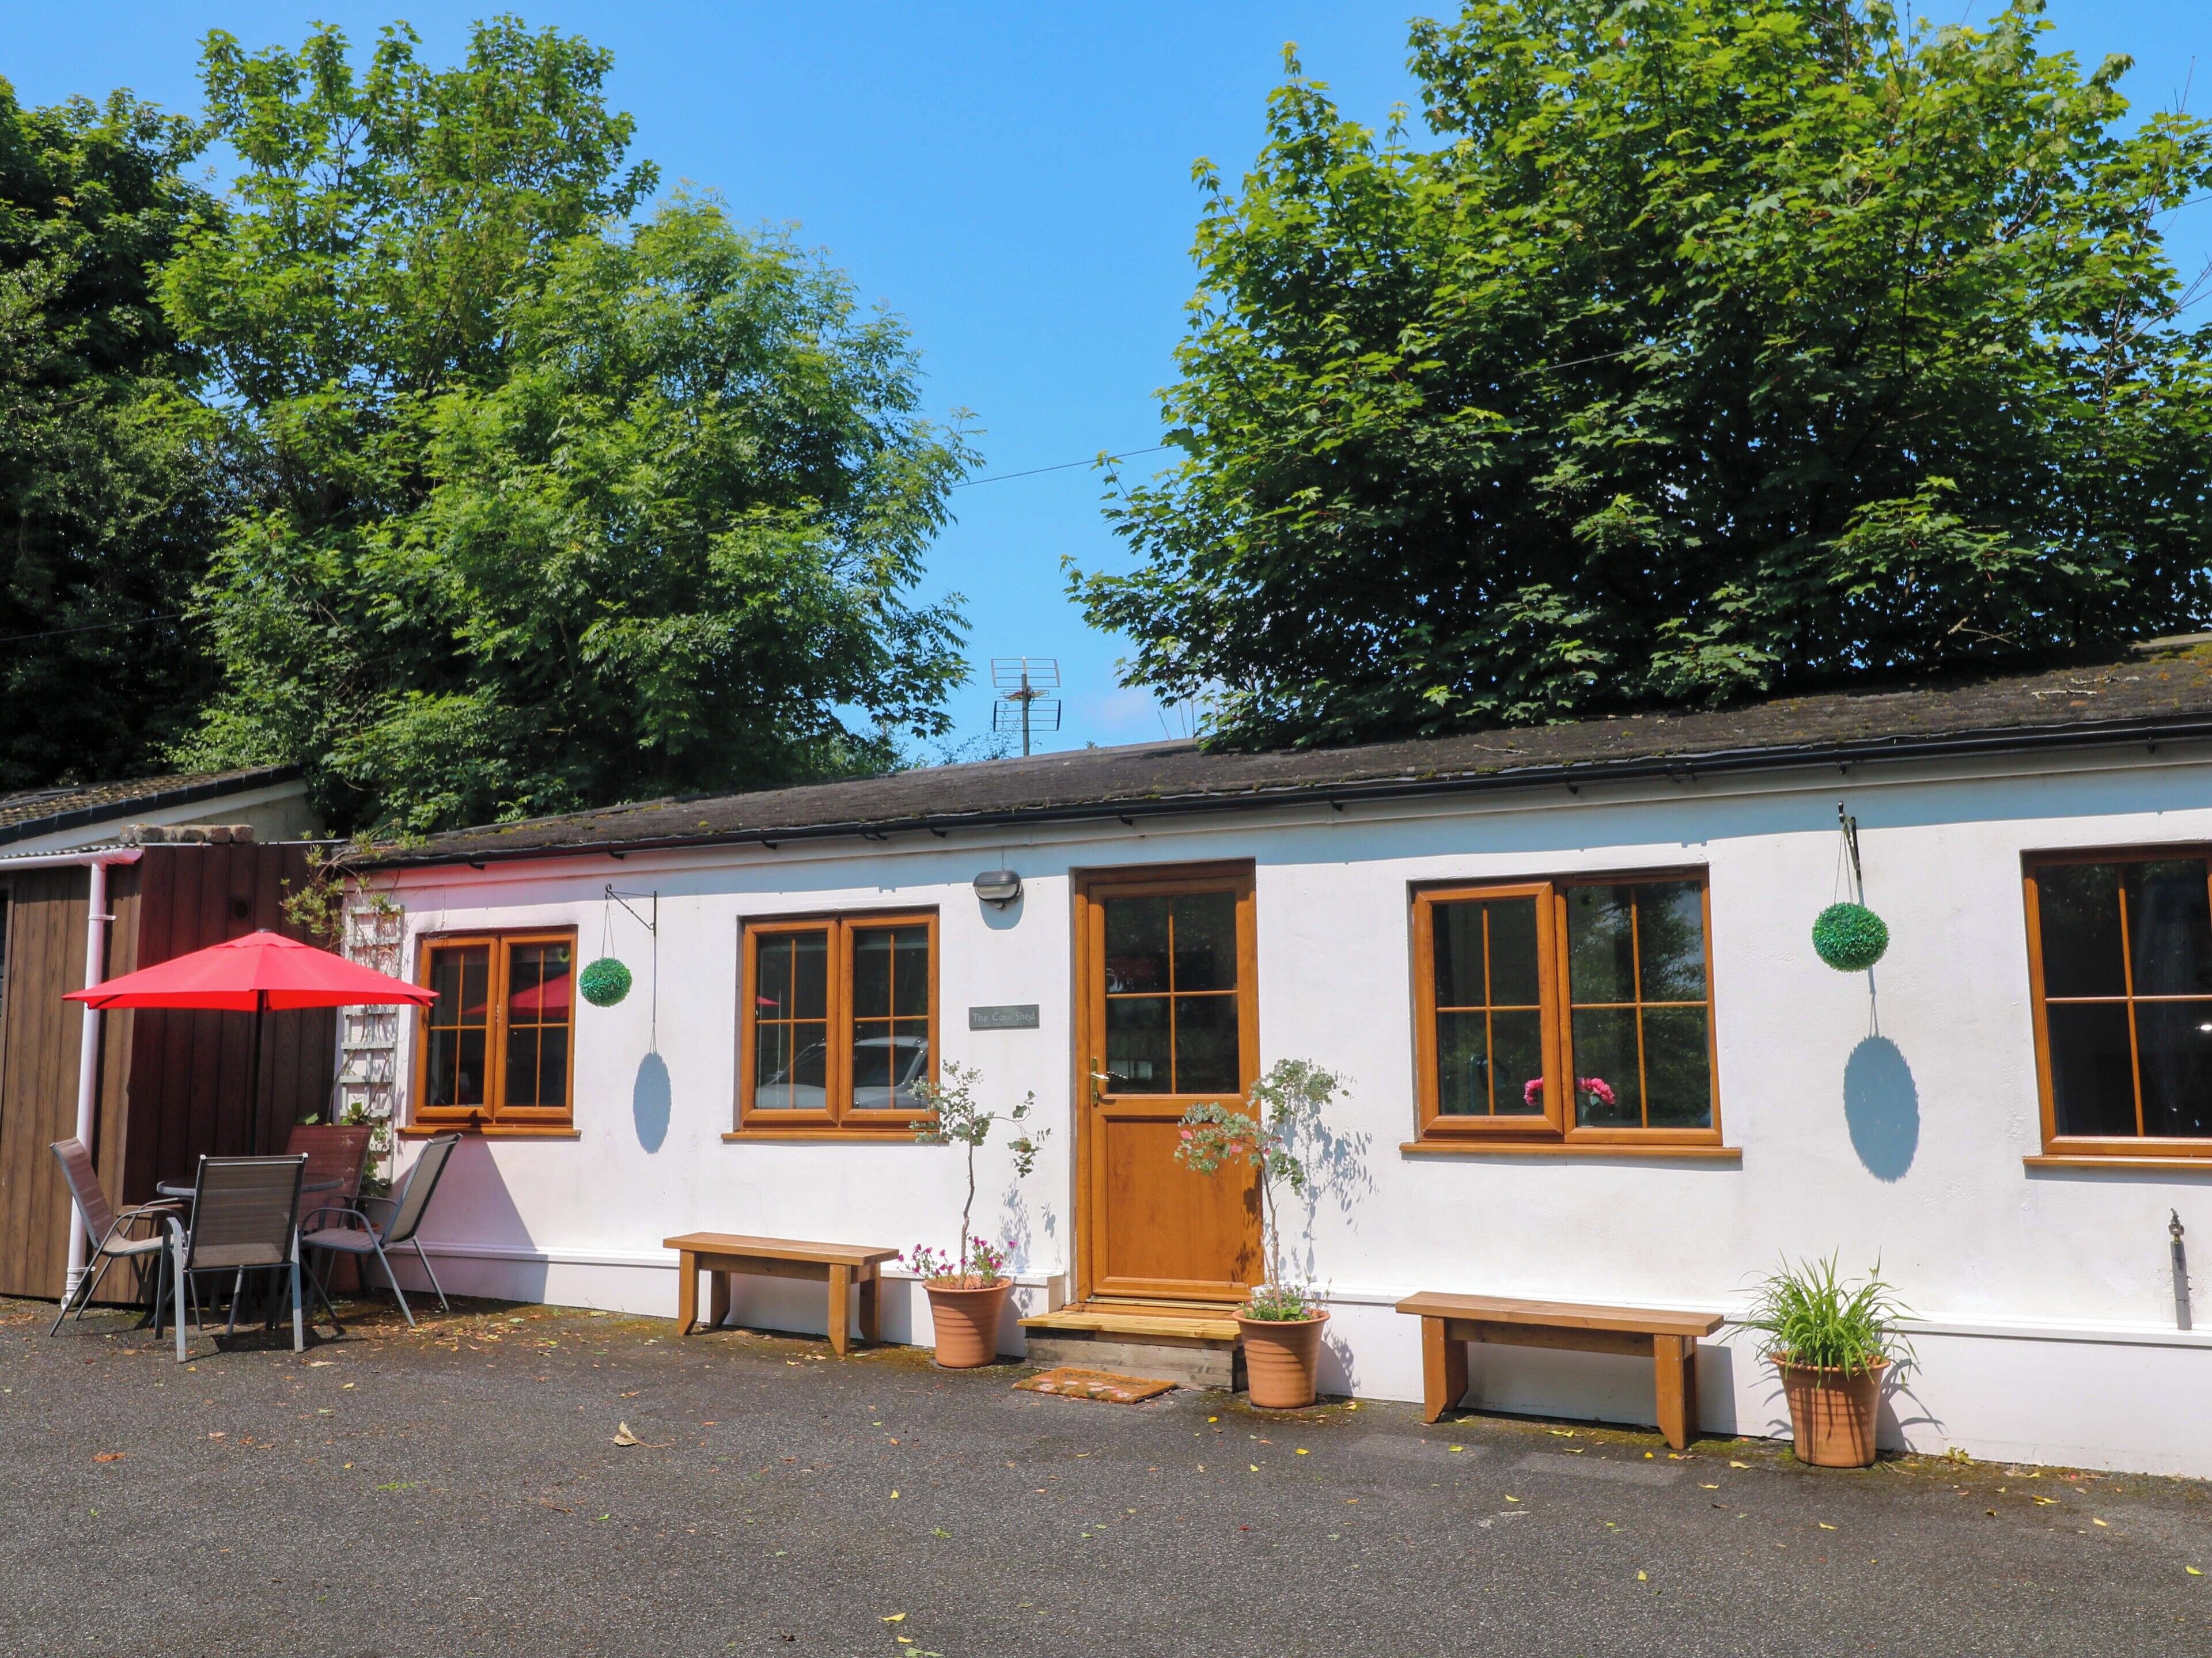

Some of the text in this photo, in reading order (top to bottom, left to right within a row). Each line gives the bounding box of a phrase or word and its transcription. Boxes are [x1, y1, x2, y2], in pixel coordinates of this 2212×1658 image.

[972, 1011, 1035, 1022] The Cow Shed
